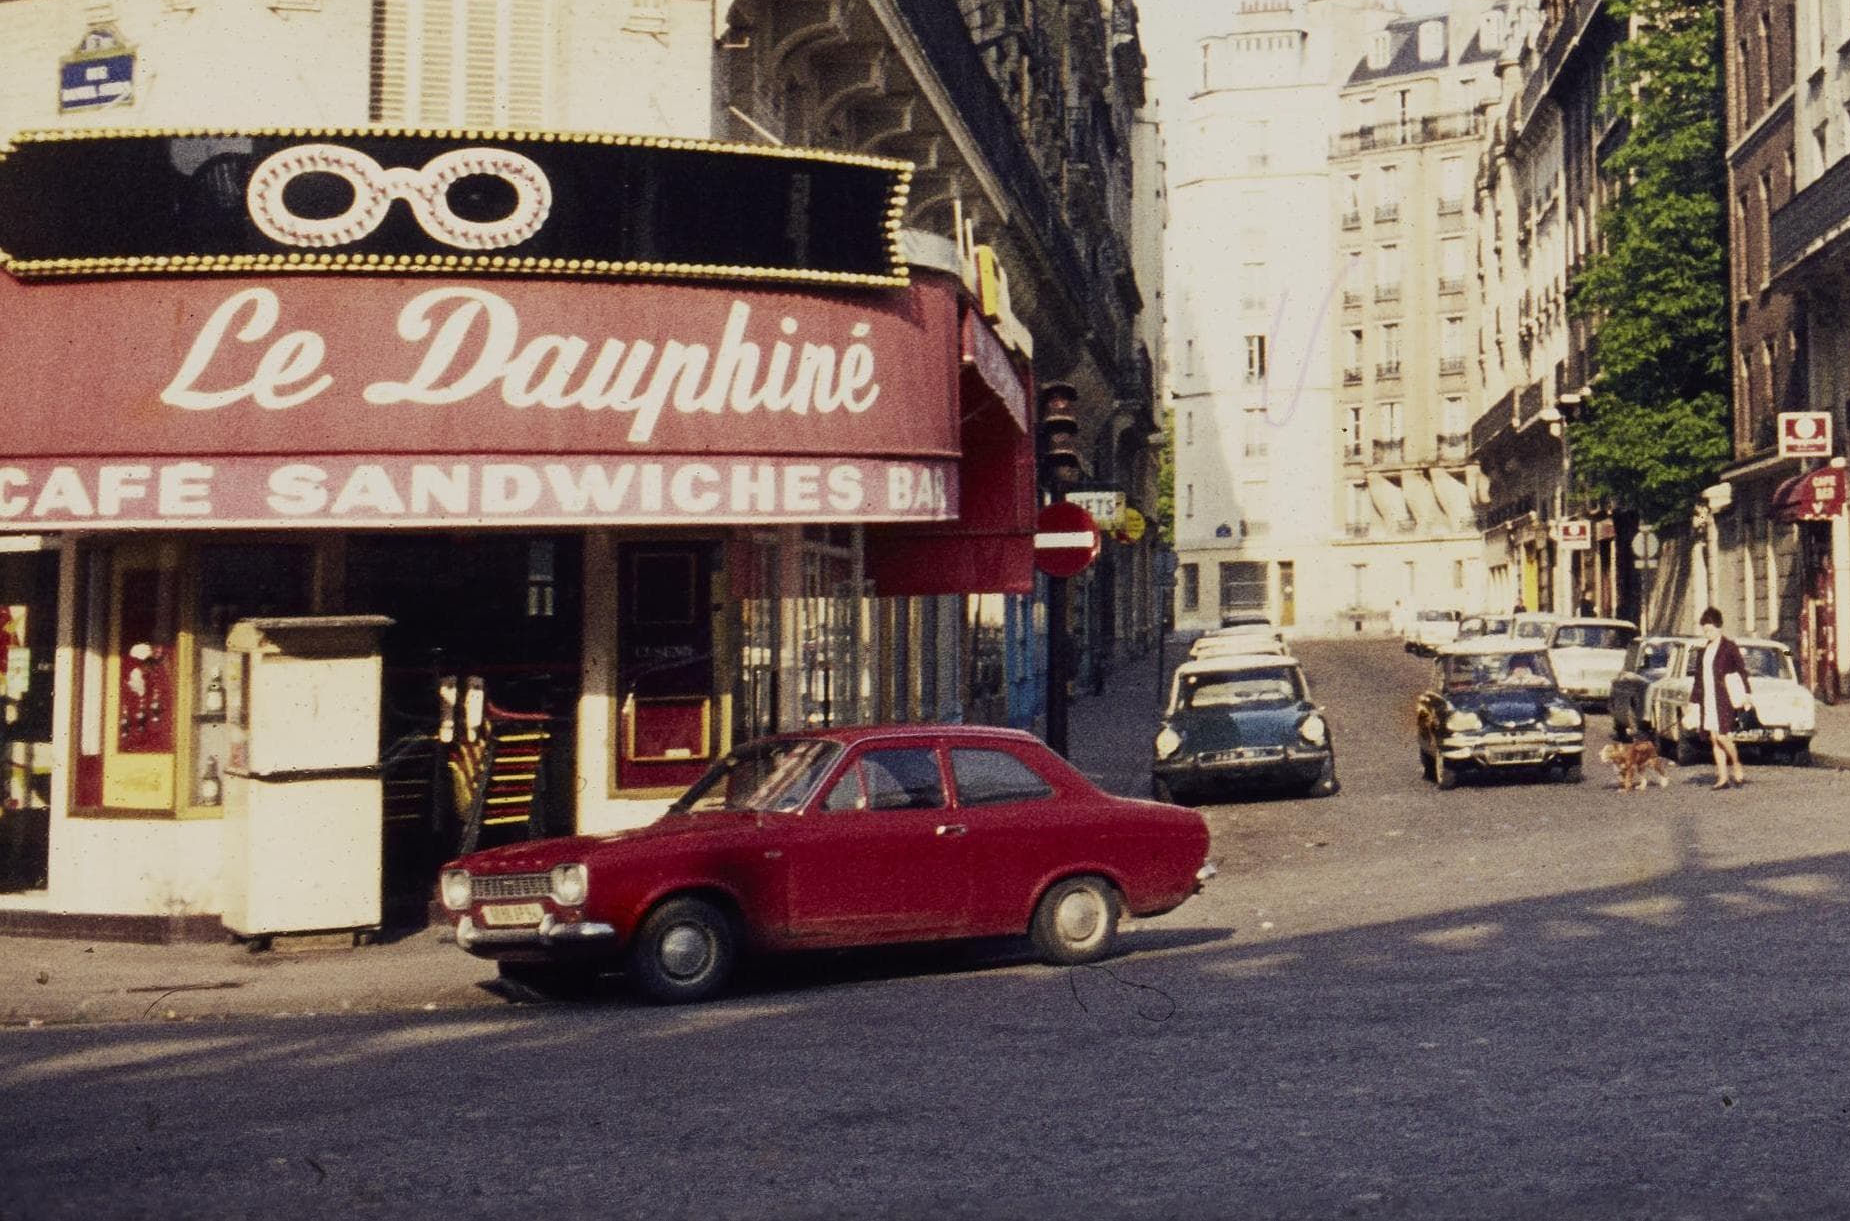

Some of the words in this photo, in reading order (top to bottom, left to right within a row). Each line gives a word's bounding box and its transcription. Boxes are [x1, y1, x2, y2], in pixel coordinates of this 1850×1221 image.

[160, 286, 334, 411] Le
[363, 285, 881, 444] Dauphiné
[266, 462, 866, 515] SANDWICHES
[888, 466, 947, 515] BAR
